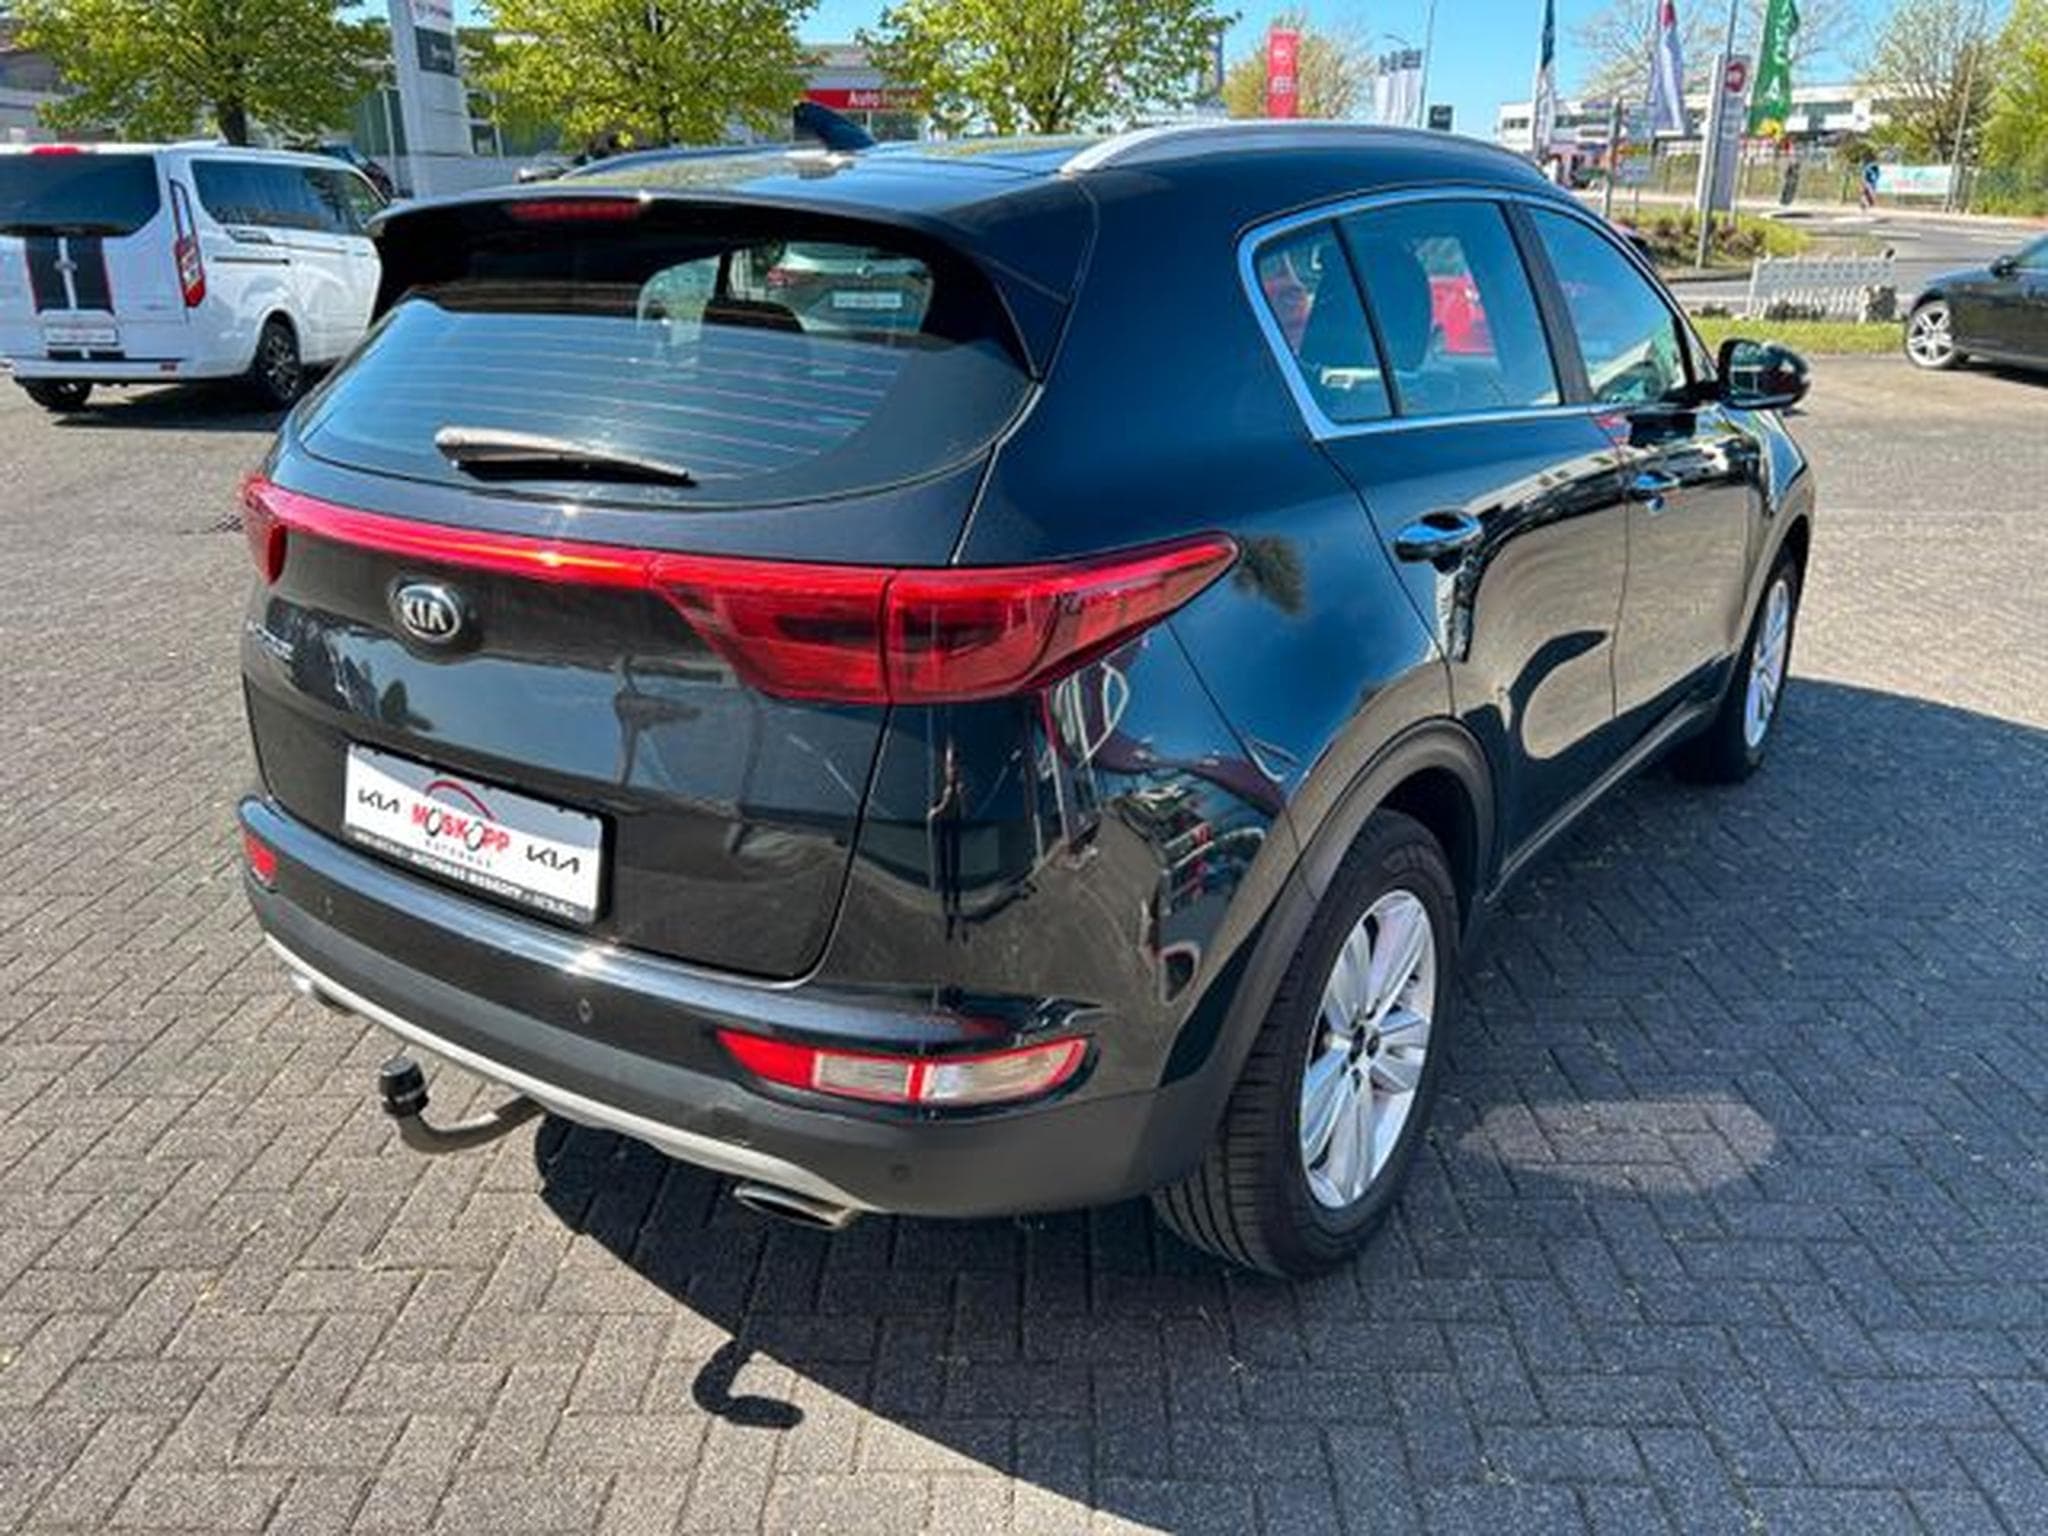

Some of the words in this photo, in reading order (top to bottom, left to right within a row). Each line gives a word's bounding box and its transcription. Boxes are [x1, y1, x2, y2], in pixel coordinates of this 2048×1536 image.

[401, 591, 448, 632] KIA
[357, 788, 400, 815] KIA
[526, 844, 580, 876] KIA
